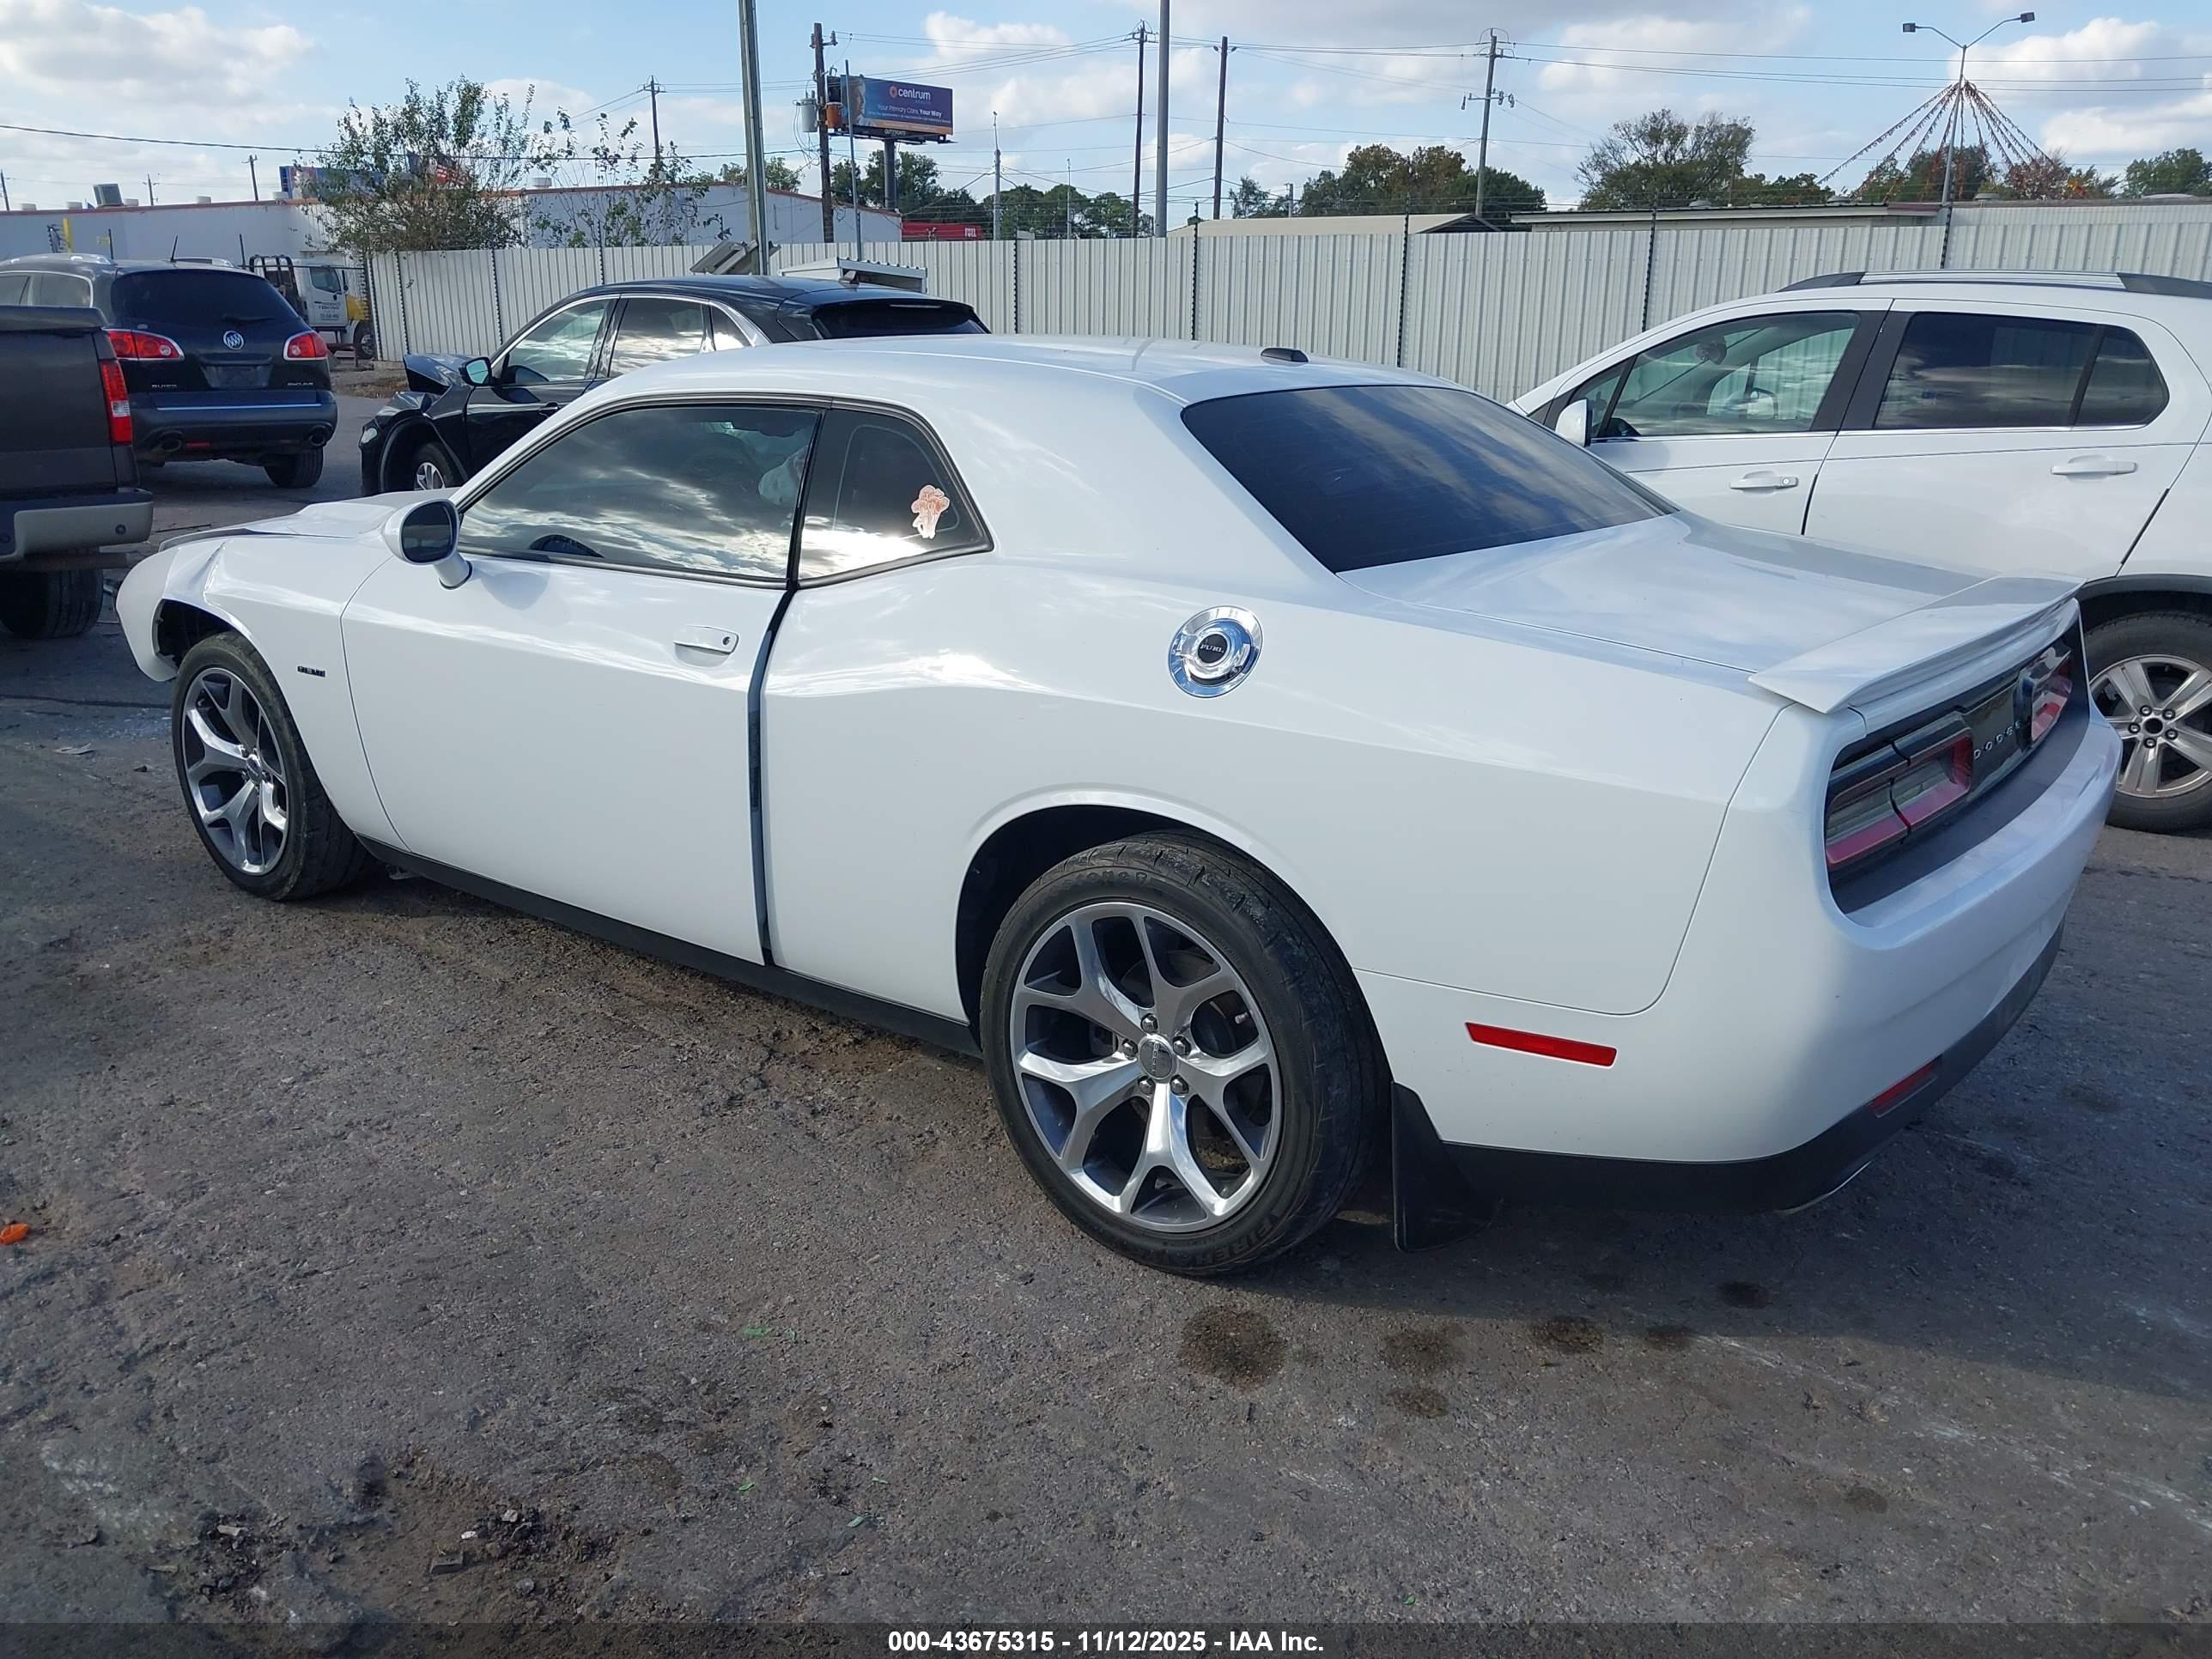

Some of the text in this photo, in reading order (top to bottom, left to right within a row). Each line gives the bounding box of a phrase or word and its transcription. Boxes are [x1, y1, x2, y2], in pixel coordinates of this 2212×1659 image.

[898, 88, 931, 100] centrum
[931, 110, 942, 118] Way
[1200, 644, 1224, 653] FUEL
